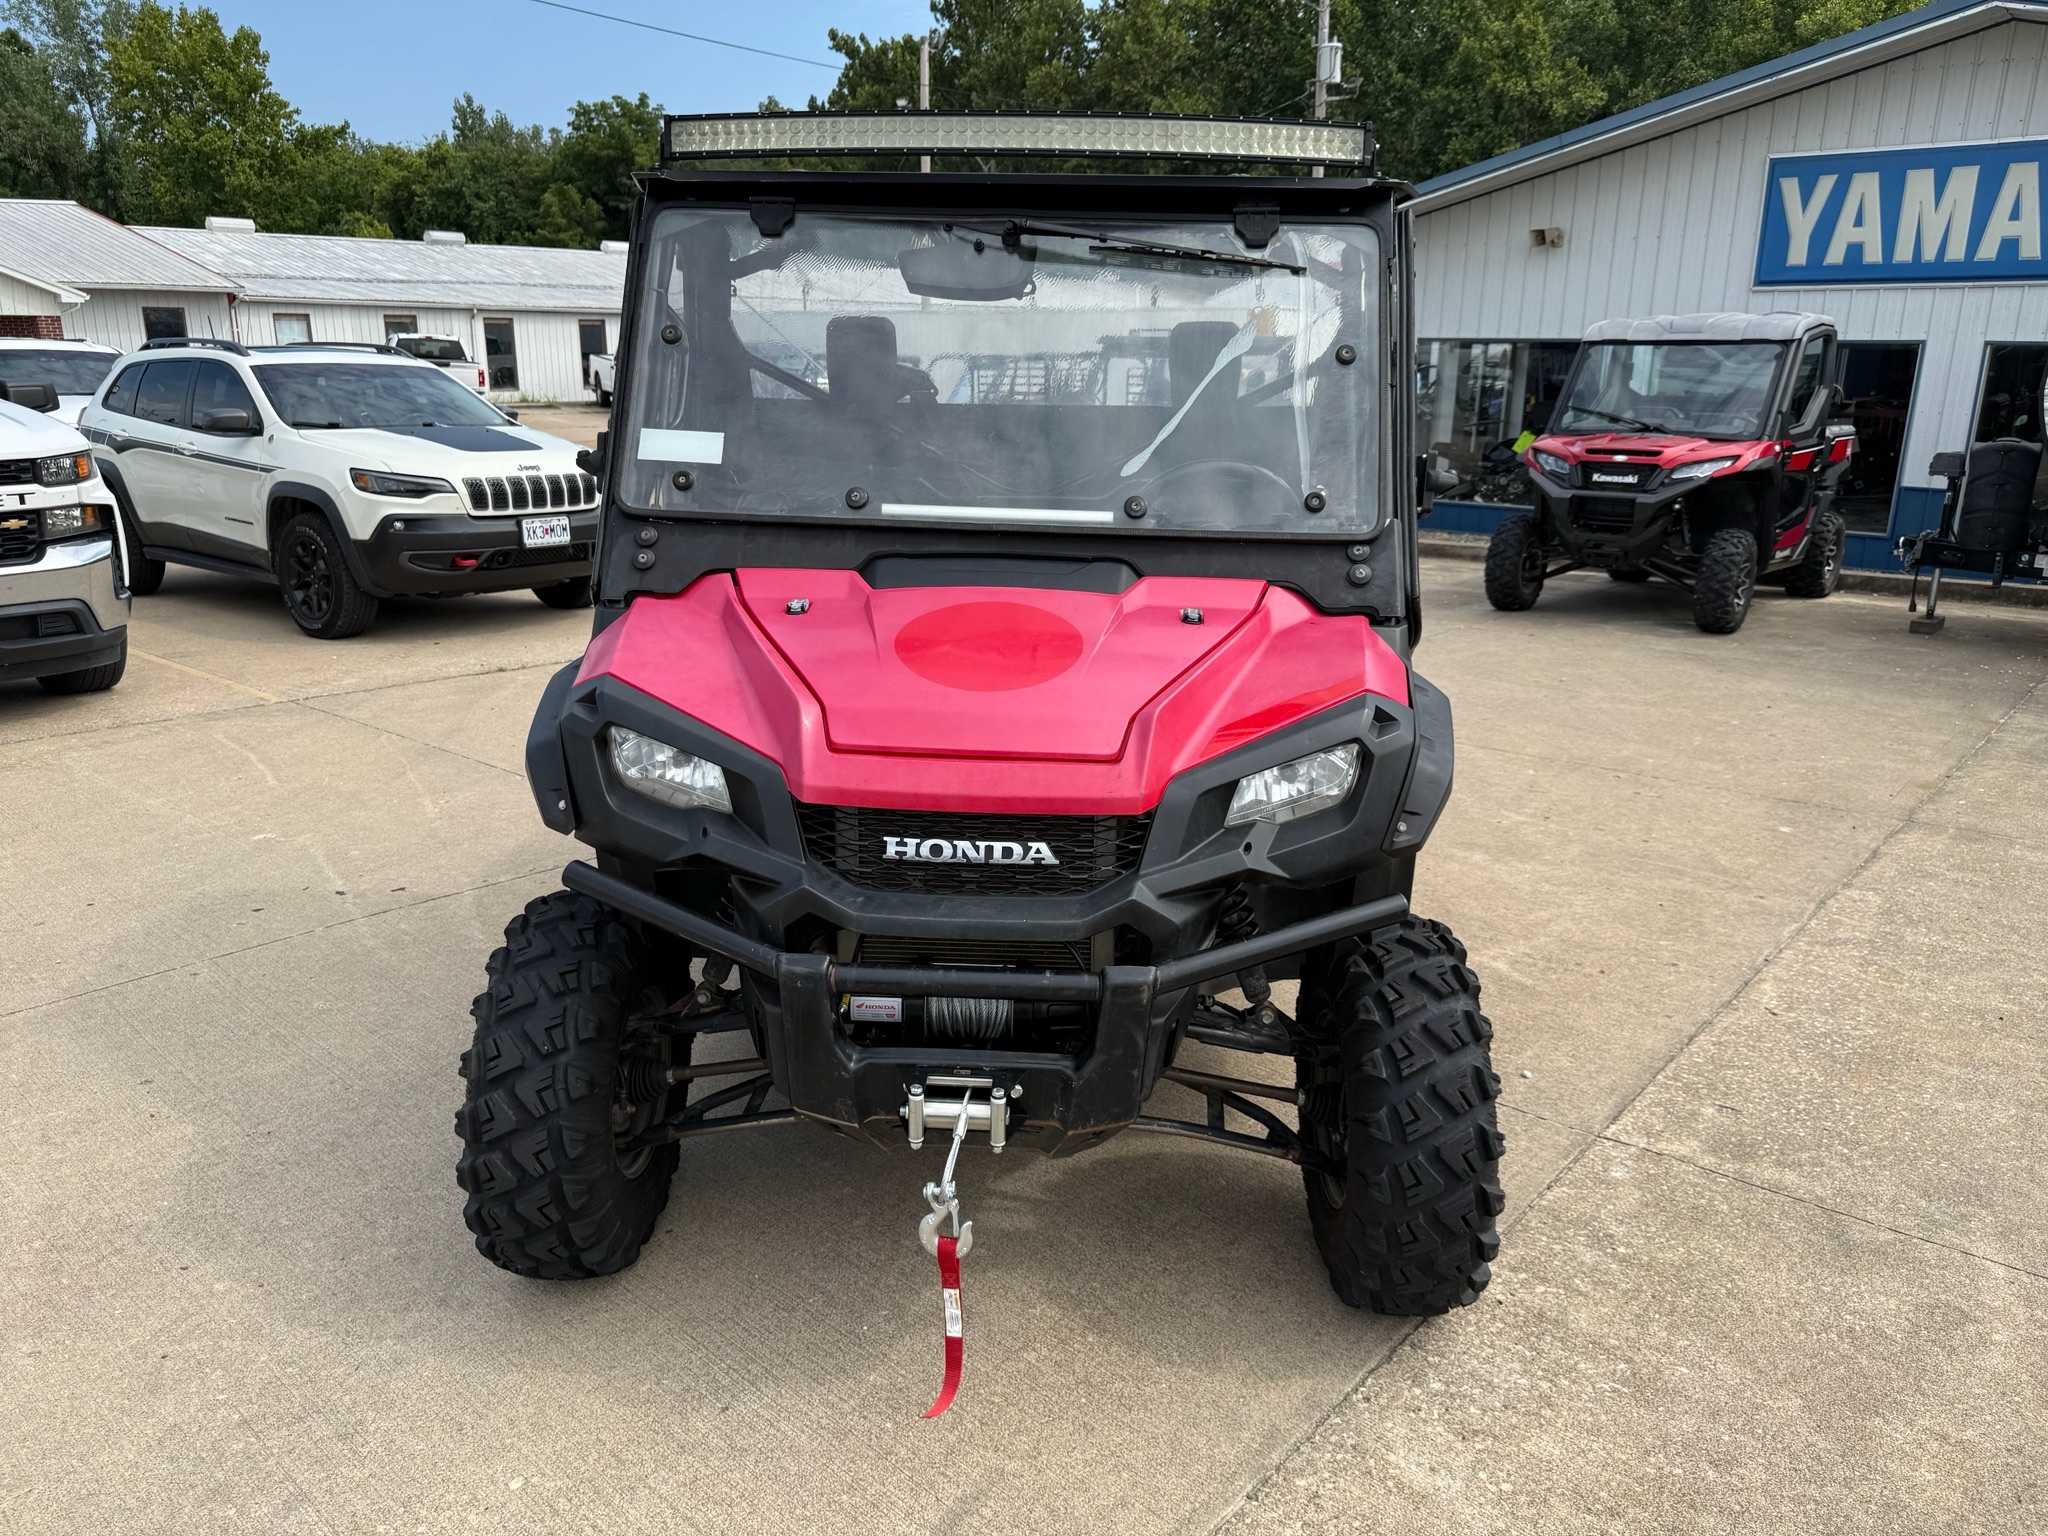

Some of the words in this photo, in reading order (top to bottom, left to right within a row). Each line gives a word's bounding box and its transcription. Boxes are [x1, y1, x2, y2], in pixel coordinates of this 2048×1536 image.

[1779, 161, 2042, 267] YAMA
[517, 464, 541, 472] Jeep
[1592, 472, 1640, 484] Kawasaki
[882, 836, 1060, 865] HONDA
